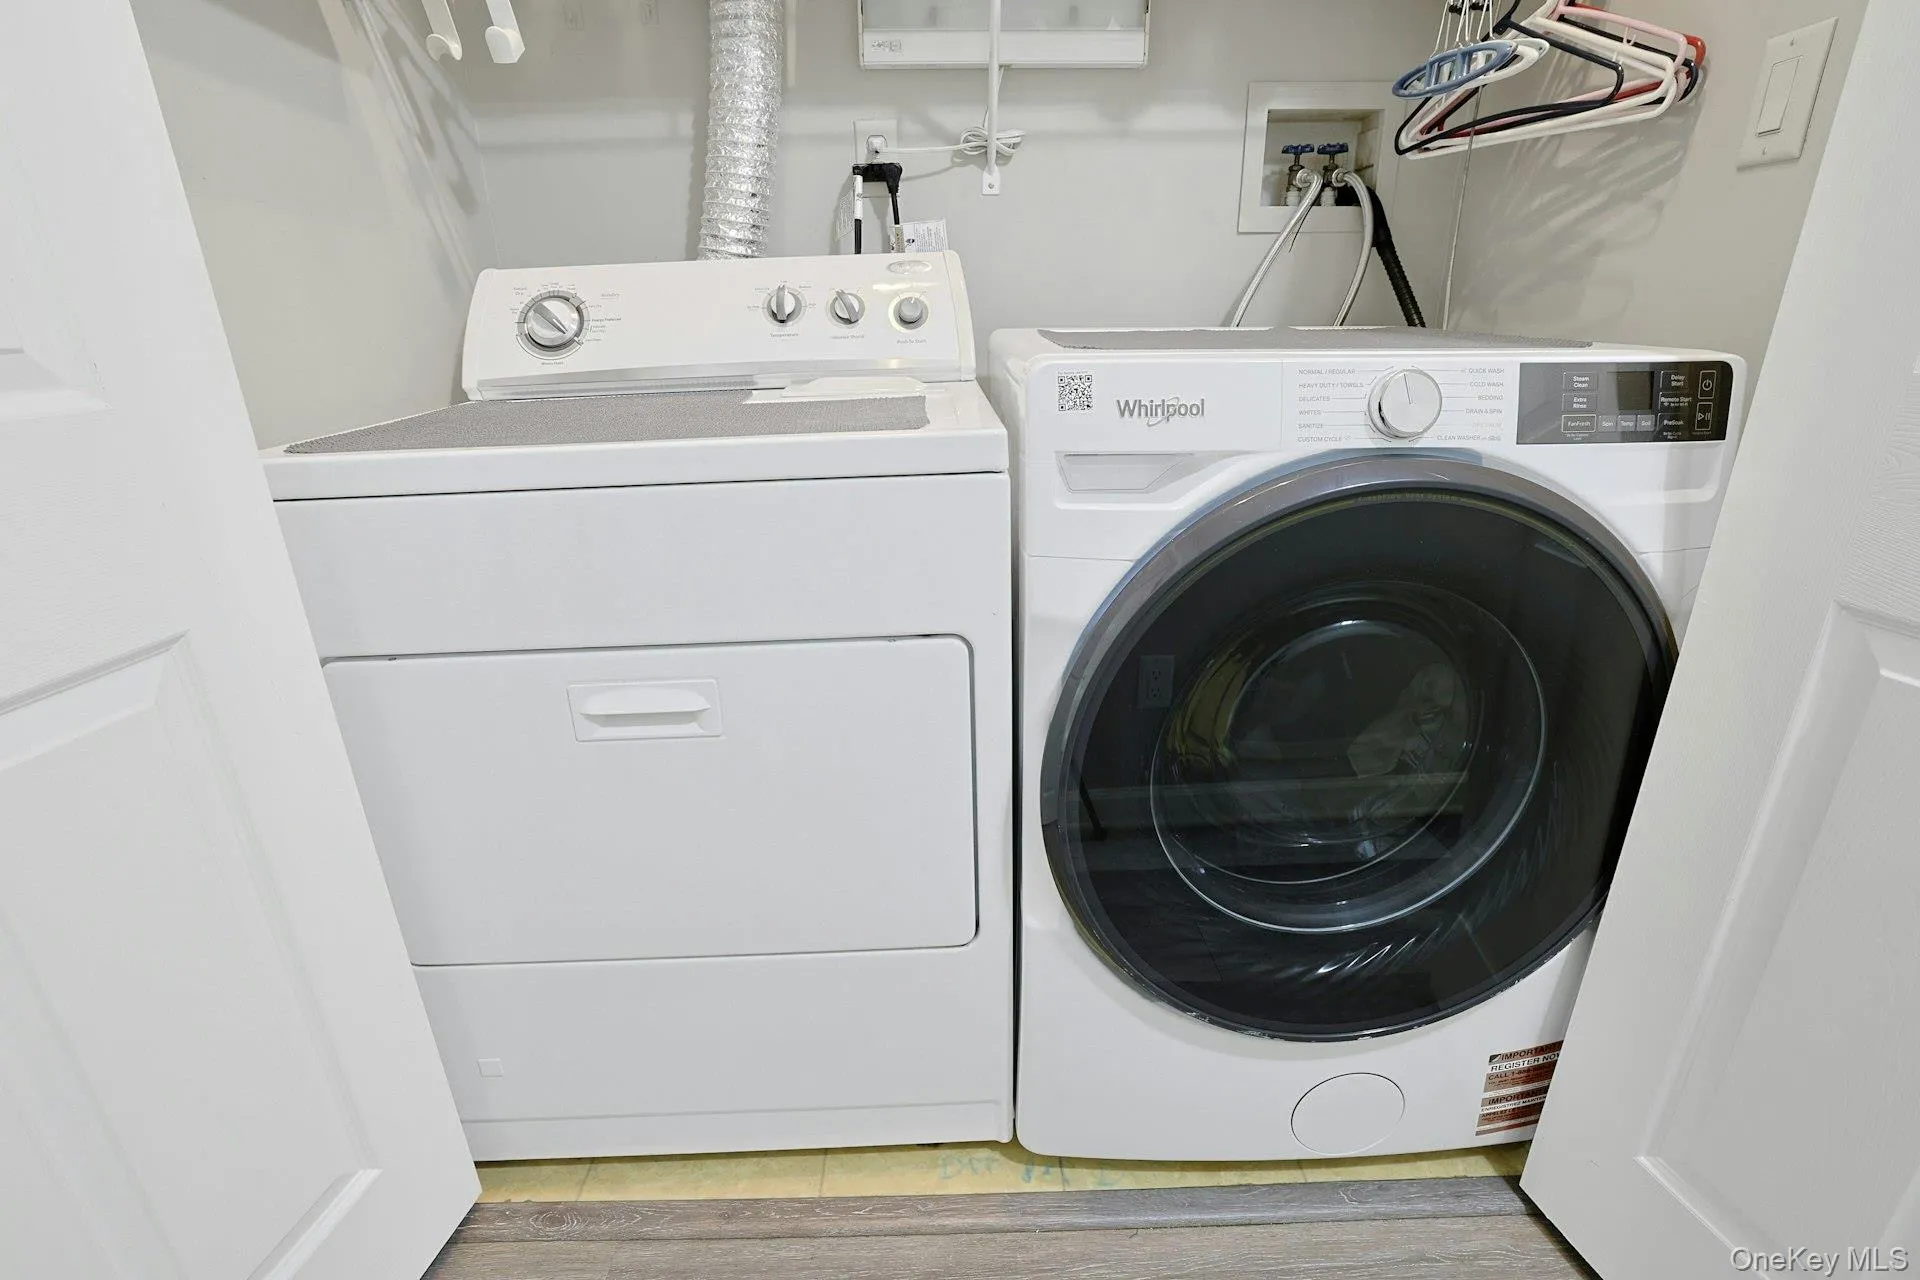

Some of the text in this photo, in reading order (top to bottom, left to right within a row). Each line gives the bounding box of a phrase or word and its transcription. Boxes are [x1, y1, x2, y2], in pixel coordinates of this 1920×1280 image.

[1116, 398, 1205, 423] Whirlpool
[1490, 1057, 1540, 1072] REGISTER
[1488, 1072, 1508, 1081] CALL
